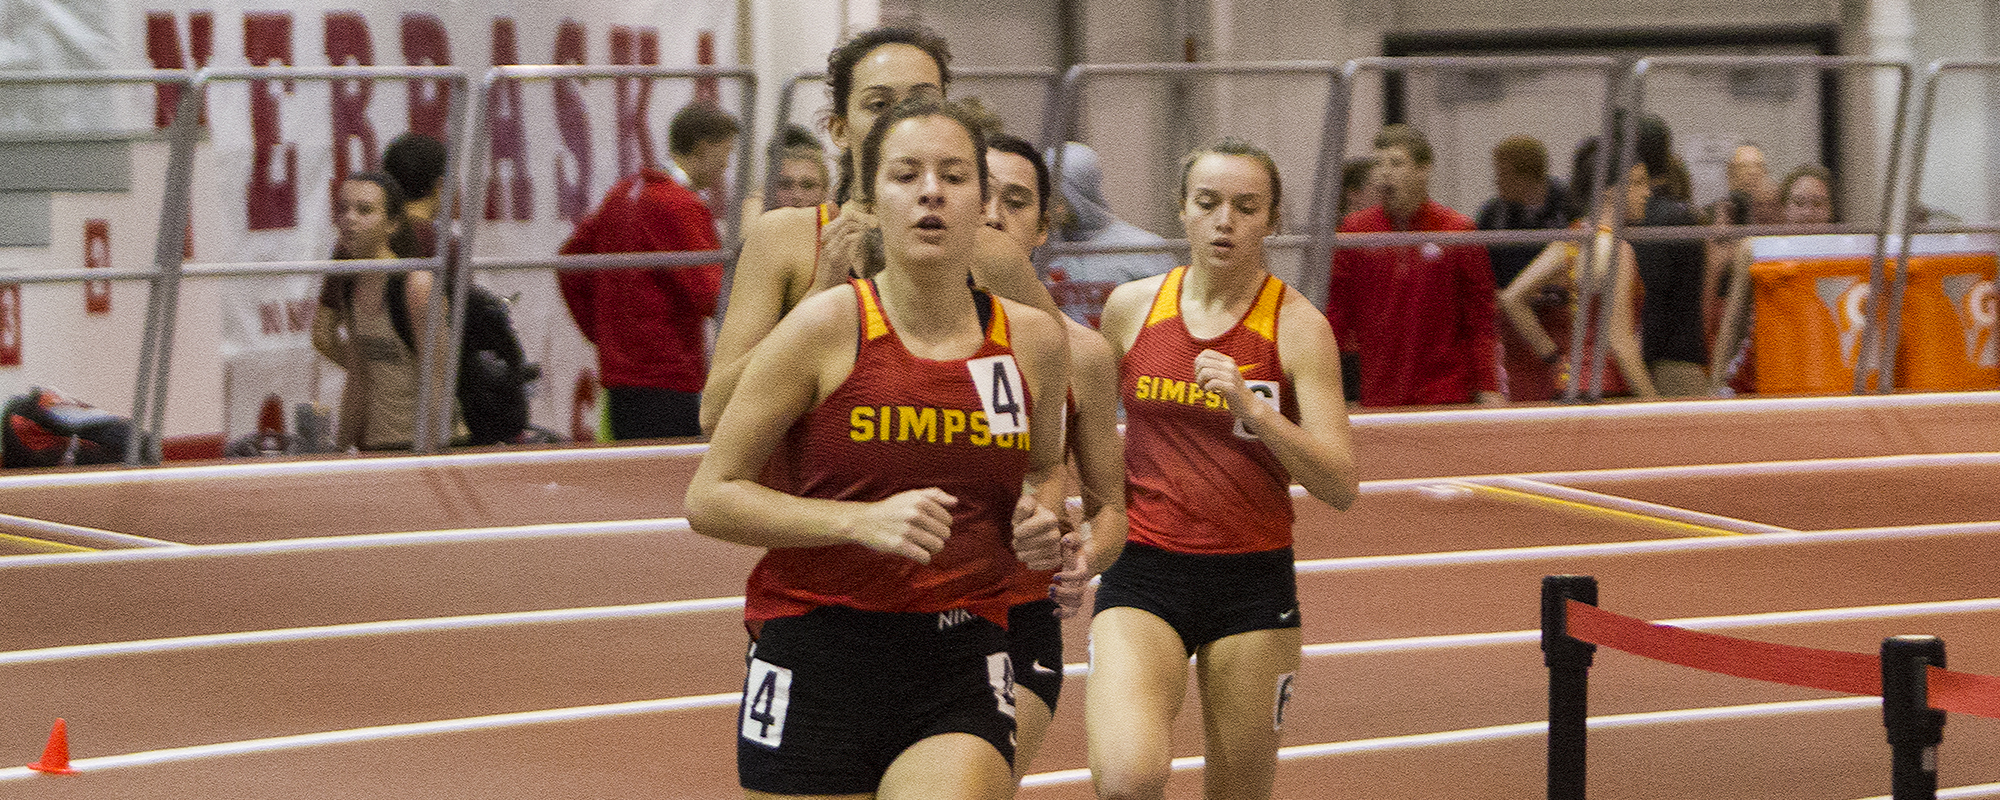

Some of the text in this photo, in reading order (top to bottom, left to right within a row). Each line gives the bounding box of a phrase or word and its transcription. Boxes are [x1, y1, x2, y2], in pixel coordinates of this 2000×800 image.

[992, 362, 1020, 427] 4
[850, 405, 1031, 451] SIMPS
[749, 669, 777, 738] 4
